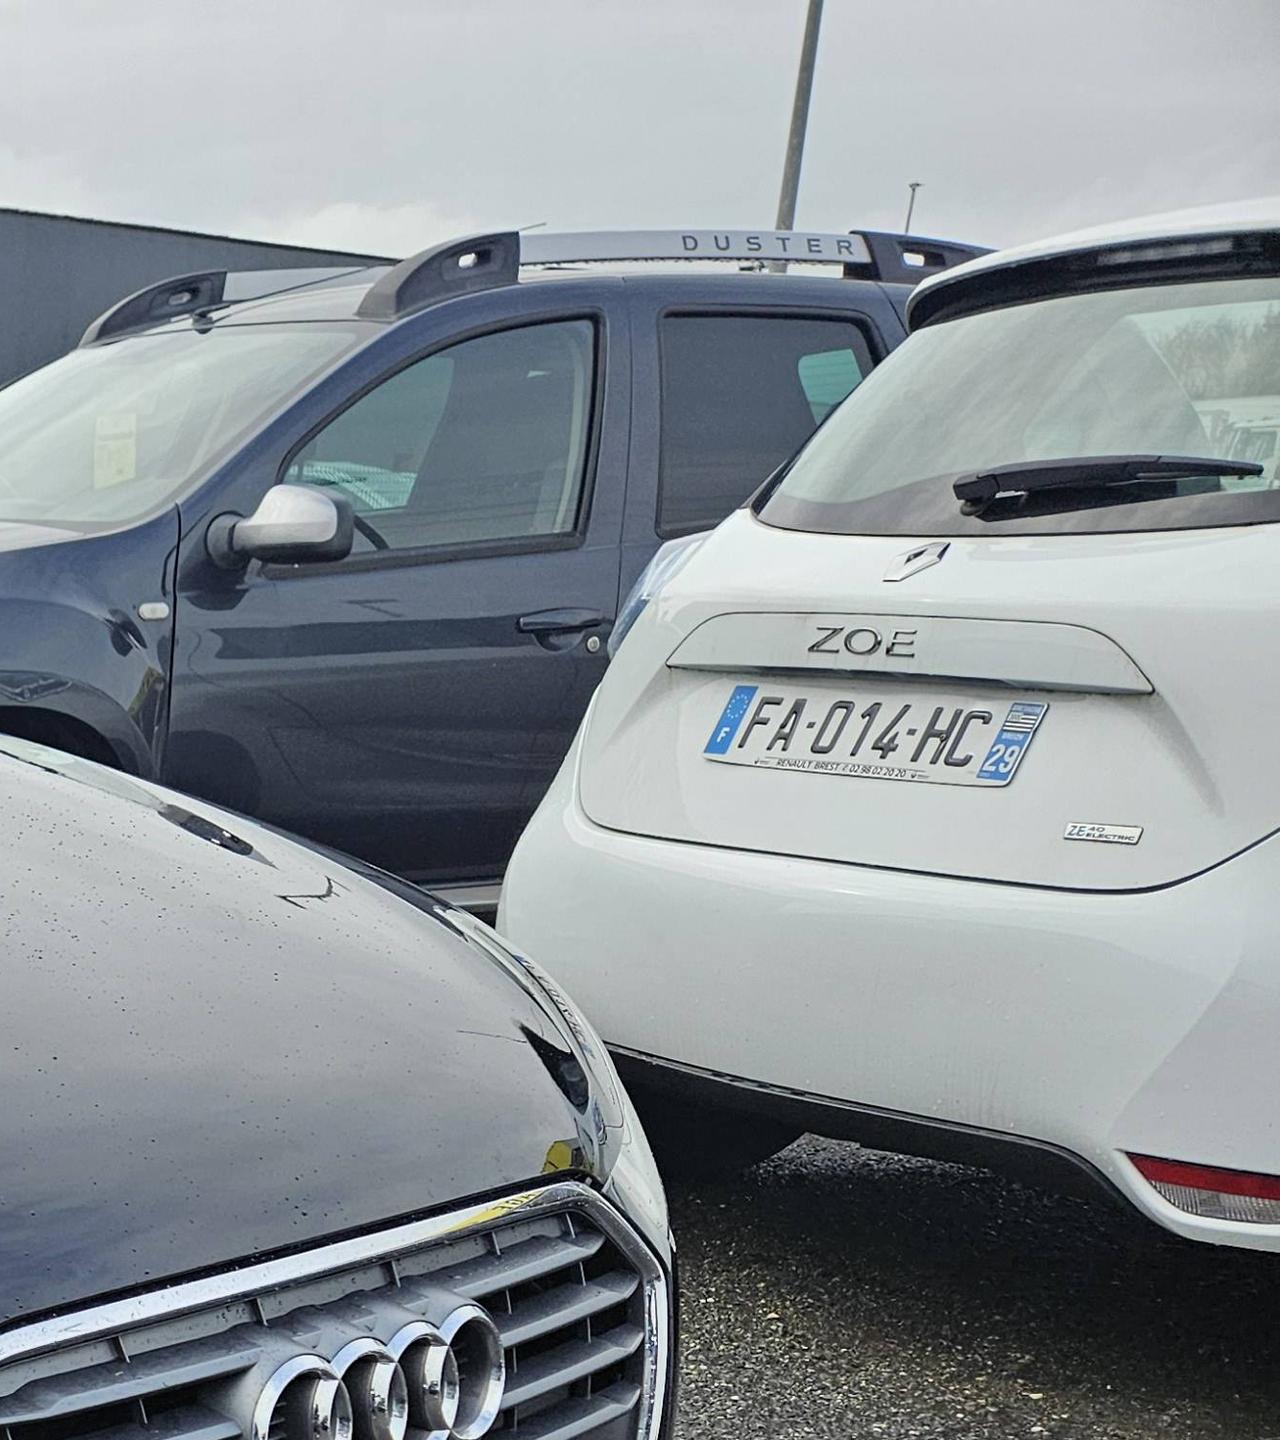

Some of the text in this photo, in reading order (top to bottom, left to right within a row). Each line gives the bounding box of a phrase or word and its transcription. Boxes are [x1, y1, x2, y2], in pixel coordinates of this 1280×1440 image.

[681, 234, 854, 255] DUSTER
[807, 625, 918, 659] ZOE
[716, 726, 730, 743] F
[737, 696, 993, 768] FA-014-HC
[776, 758, 812, 769] RENAULT
[814, 761, 840, 772] BREST
[981, 743, 1020, 774] 29
[1086, 832, 1135, 841] ELECTRIC
